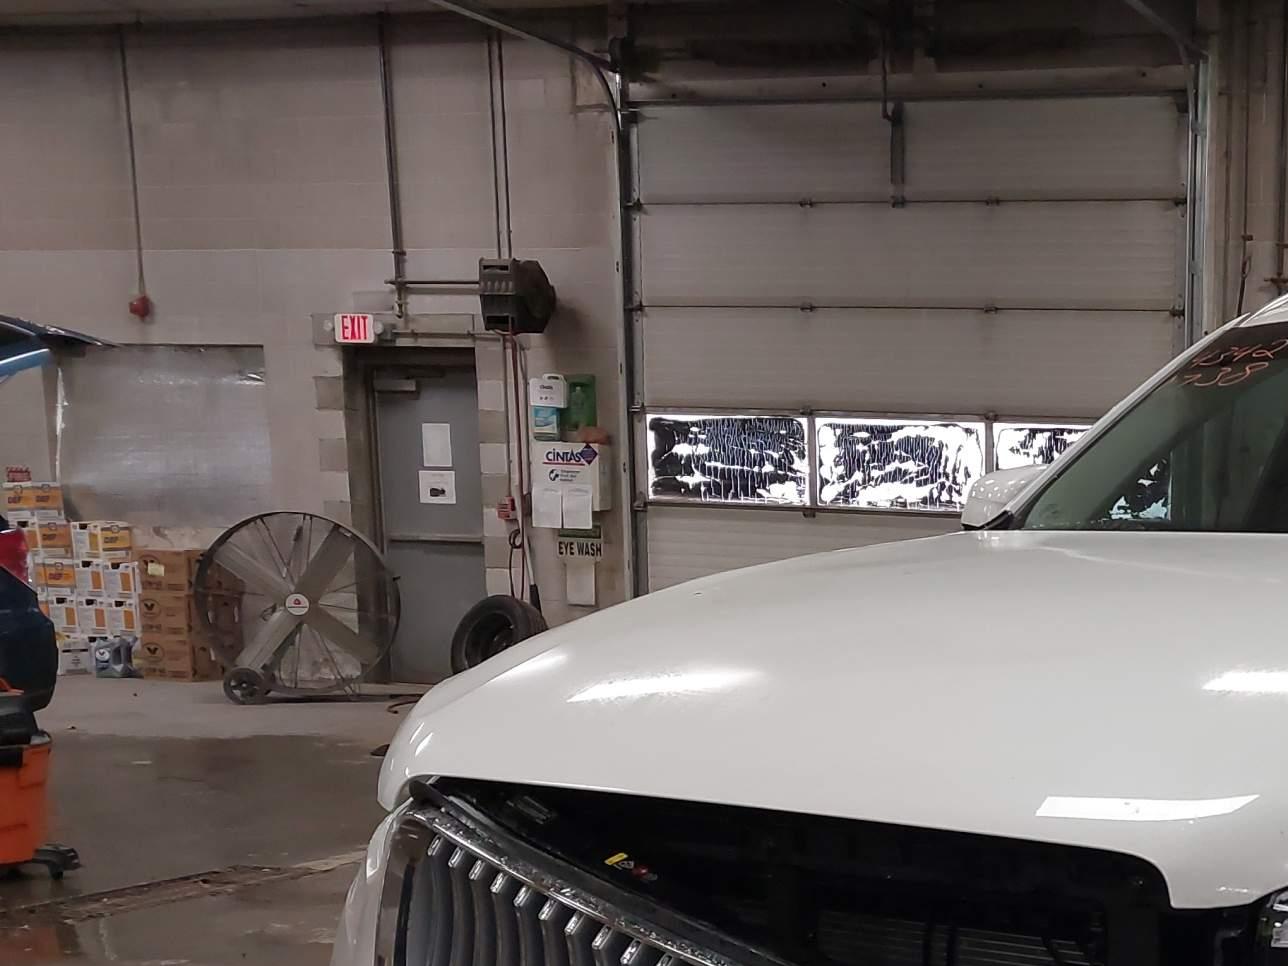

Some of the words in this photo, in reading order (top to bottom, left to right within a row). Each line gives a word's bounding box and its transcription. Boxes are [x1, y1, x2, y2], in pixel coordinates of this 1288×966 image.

[341, 315, 369, 340] EXIT
[558, 541, 575, 556] EYE
[576, 542, 602, 557] WASH
